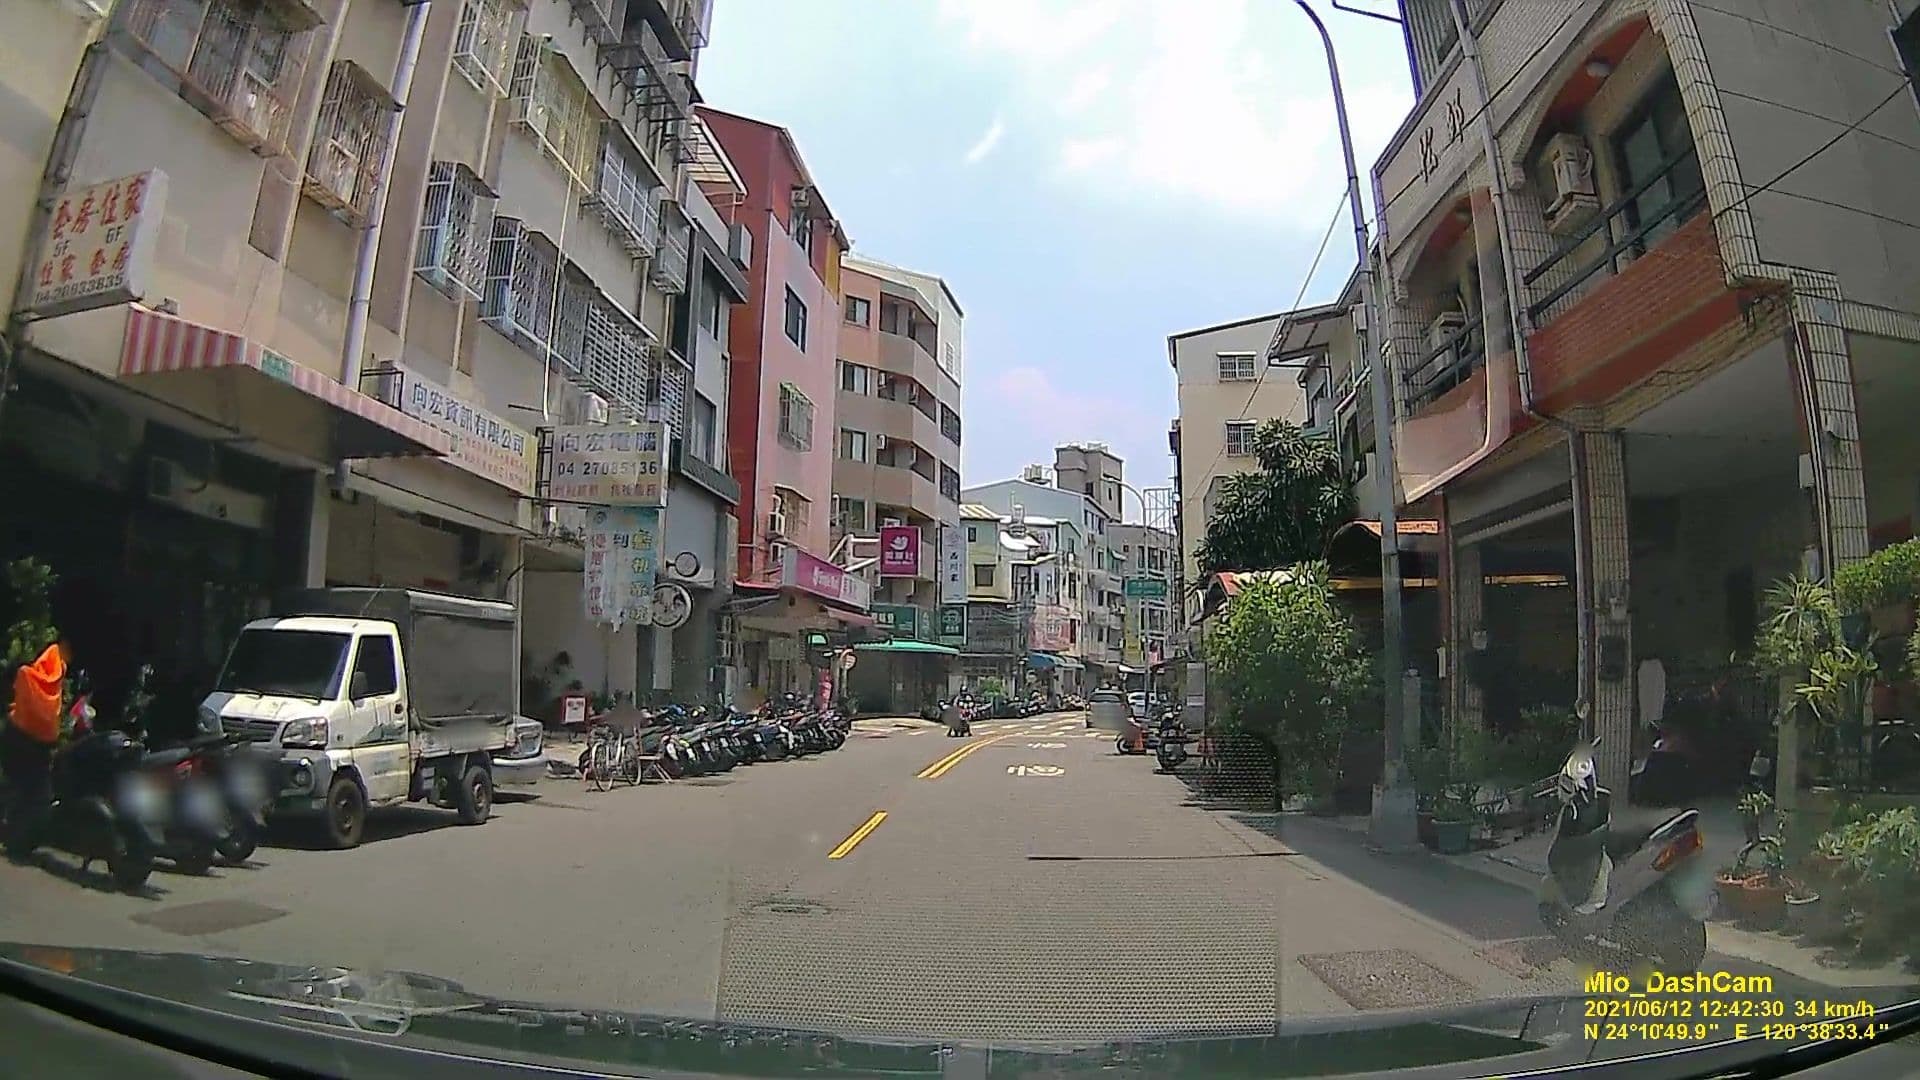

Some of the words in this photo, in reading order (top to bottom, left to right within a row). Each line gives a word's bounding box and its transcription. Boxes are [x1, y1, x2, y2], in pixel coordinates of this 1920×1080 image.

[413, 382, 524, 456] 向宏資訊有限公司
[560, 432, 657, 453] 向宏電腦
[558, 462, 575, 476] 04
